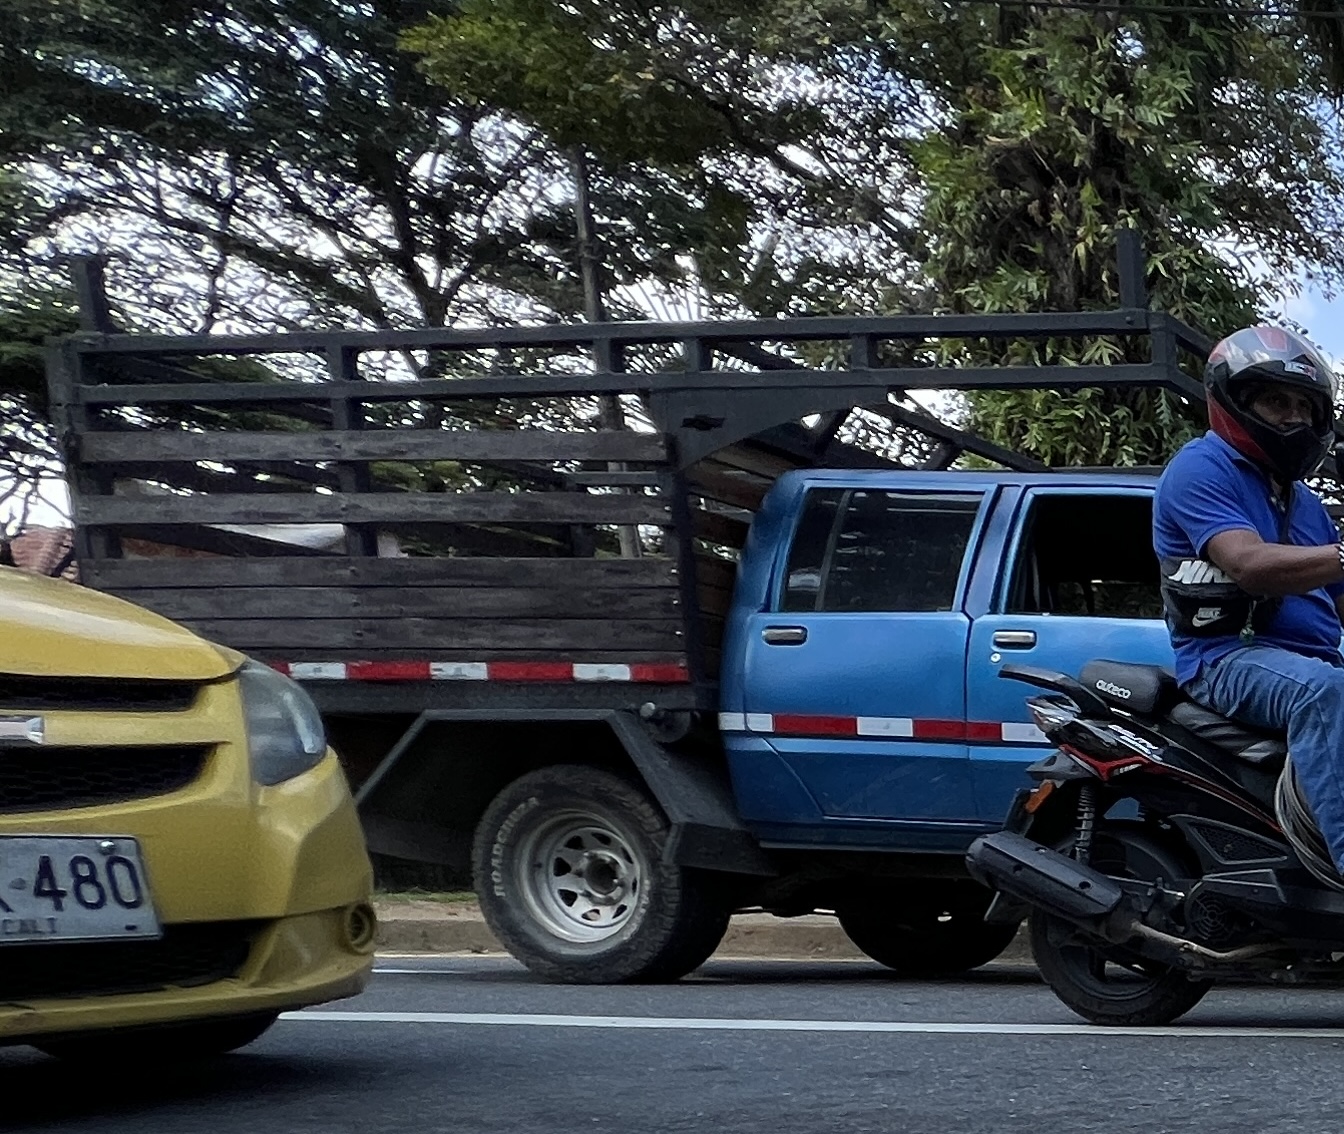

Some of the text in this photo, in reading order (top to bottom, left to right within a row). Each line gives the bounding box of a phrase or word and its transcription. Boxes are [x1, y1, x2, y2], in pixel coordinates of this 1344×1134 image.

[1168, 560, 1235, 585] NIK
[1095, 679, 1132, 700] auteco
[34, 855, 143, 912] 480
